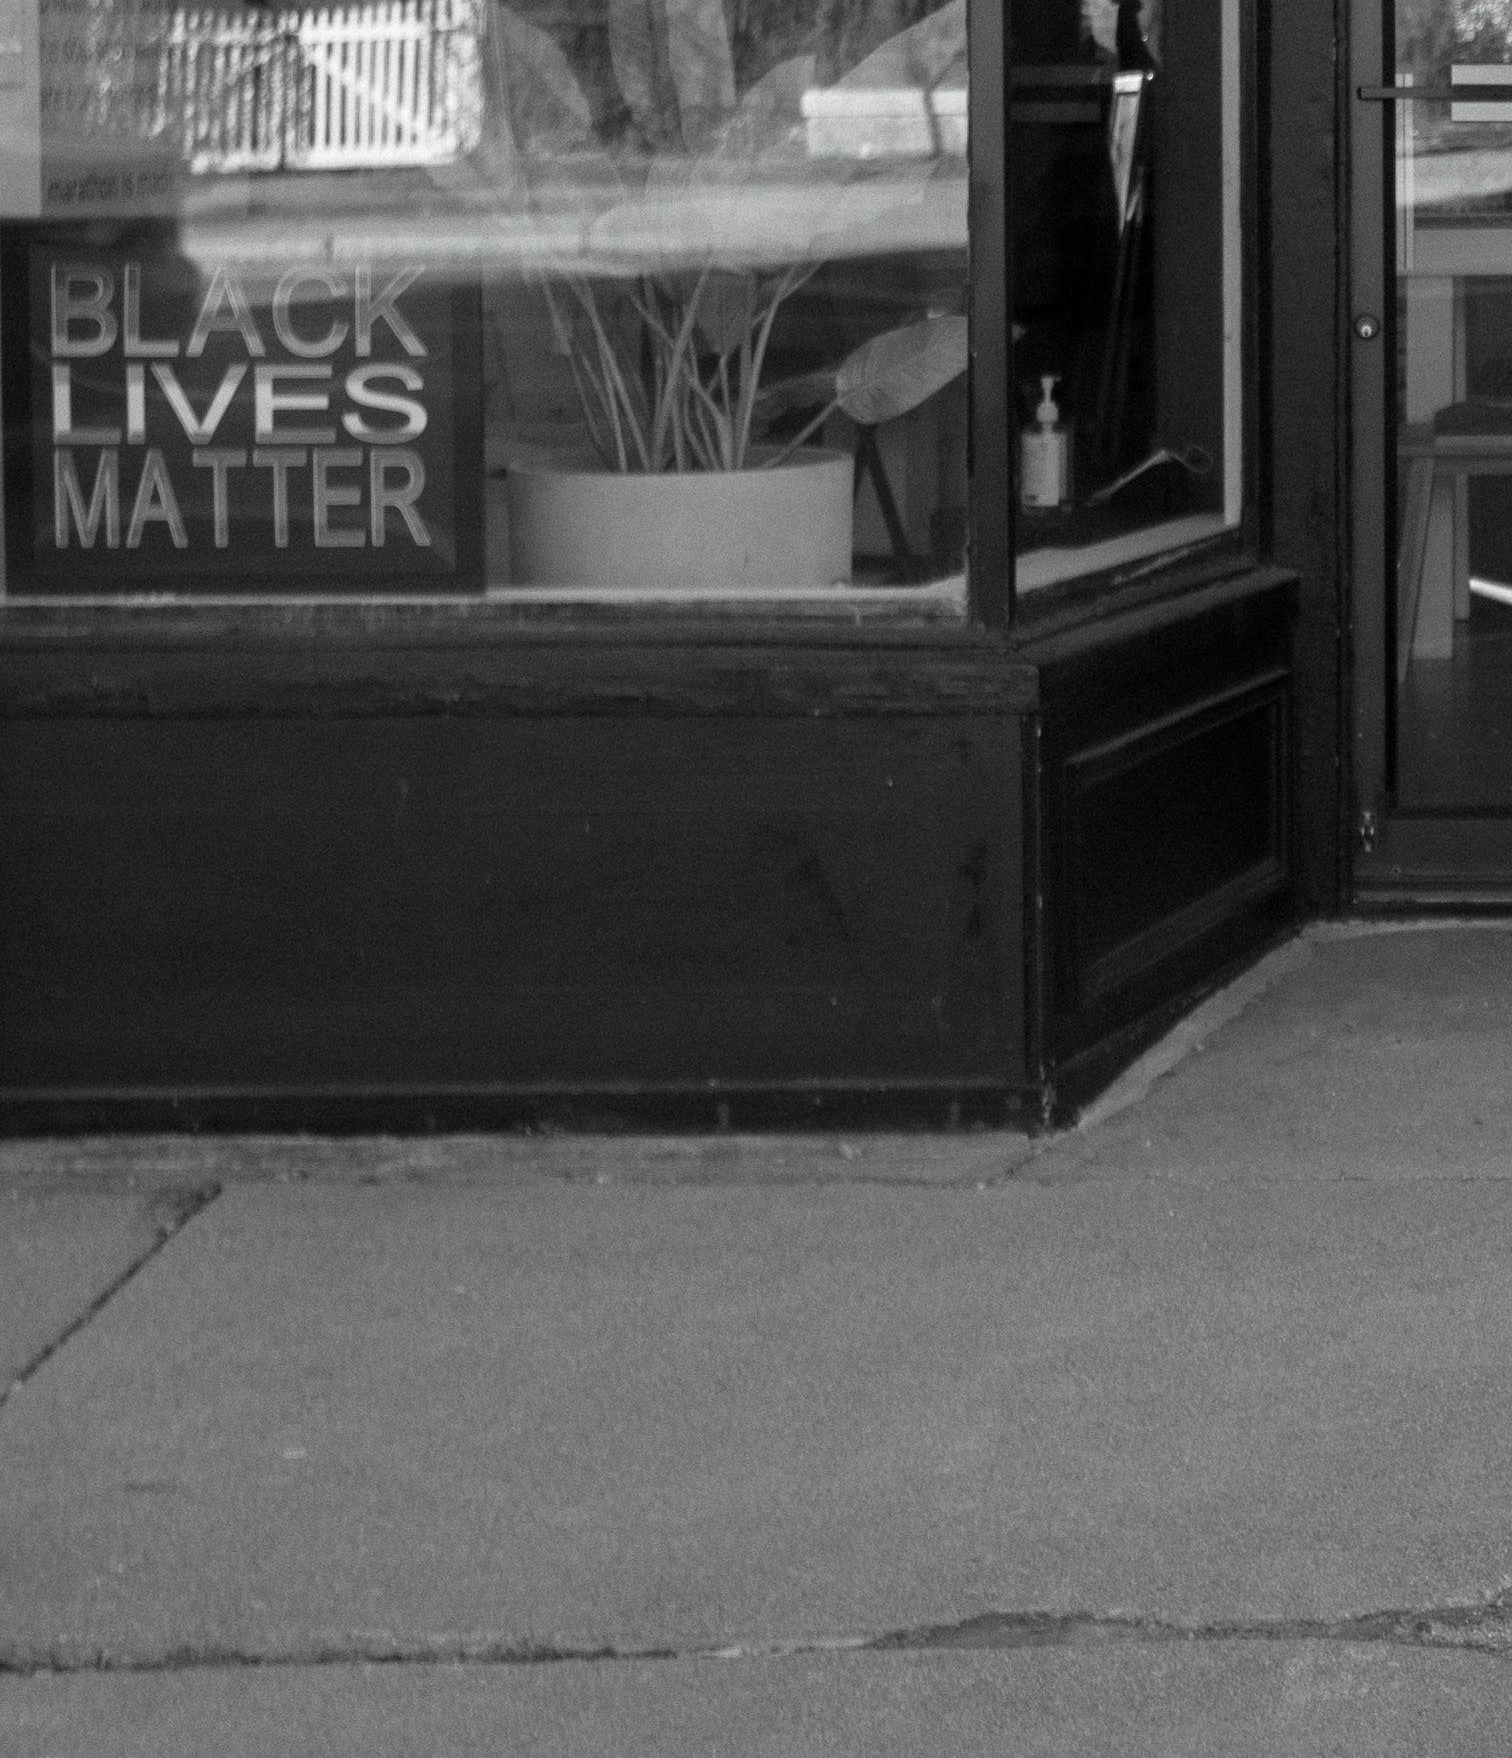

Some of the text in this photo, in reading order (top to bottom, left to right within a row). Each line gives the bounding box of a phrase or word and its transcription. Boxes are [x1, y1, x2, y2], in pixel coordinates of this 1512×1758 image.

[51, 262, 430, 359] BLACK
[52, 361, 429, 445] LIVES
[53, 445, 432, 550] MATTER
